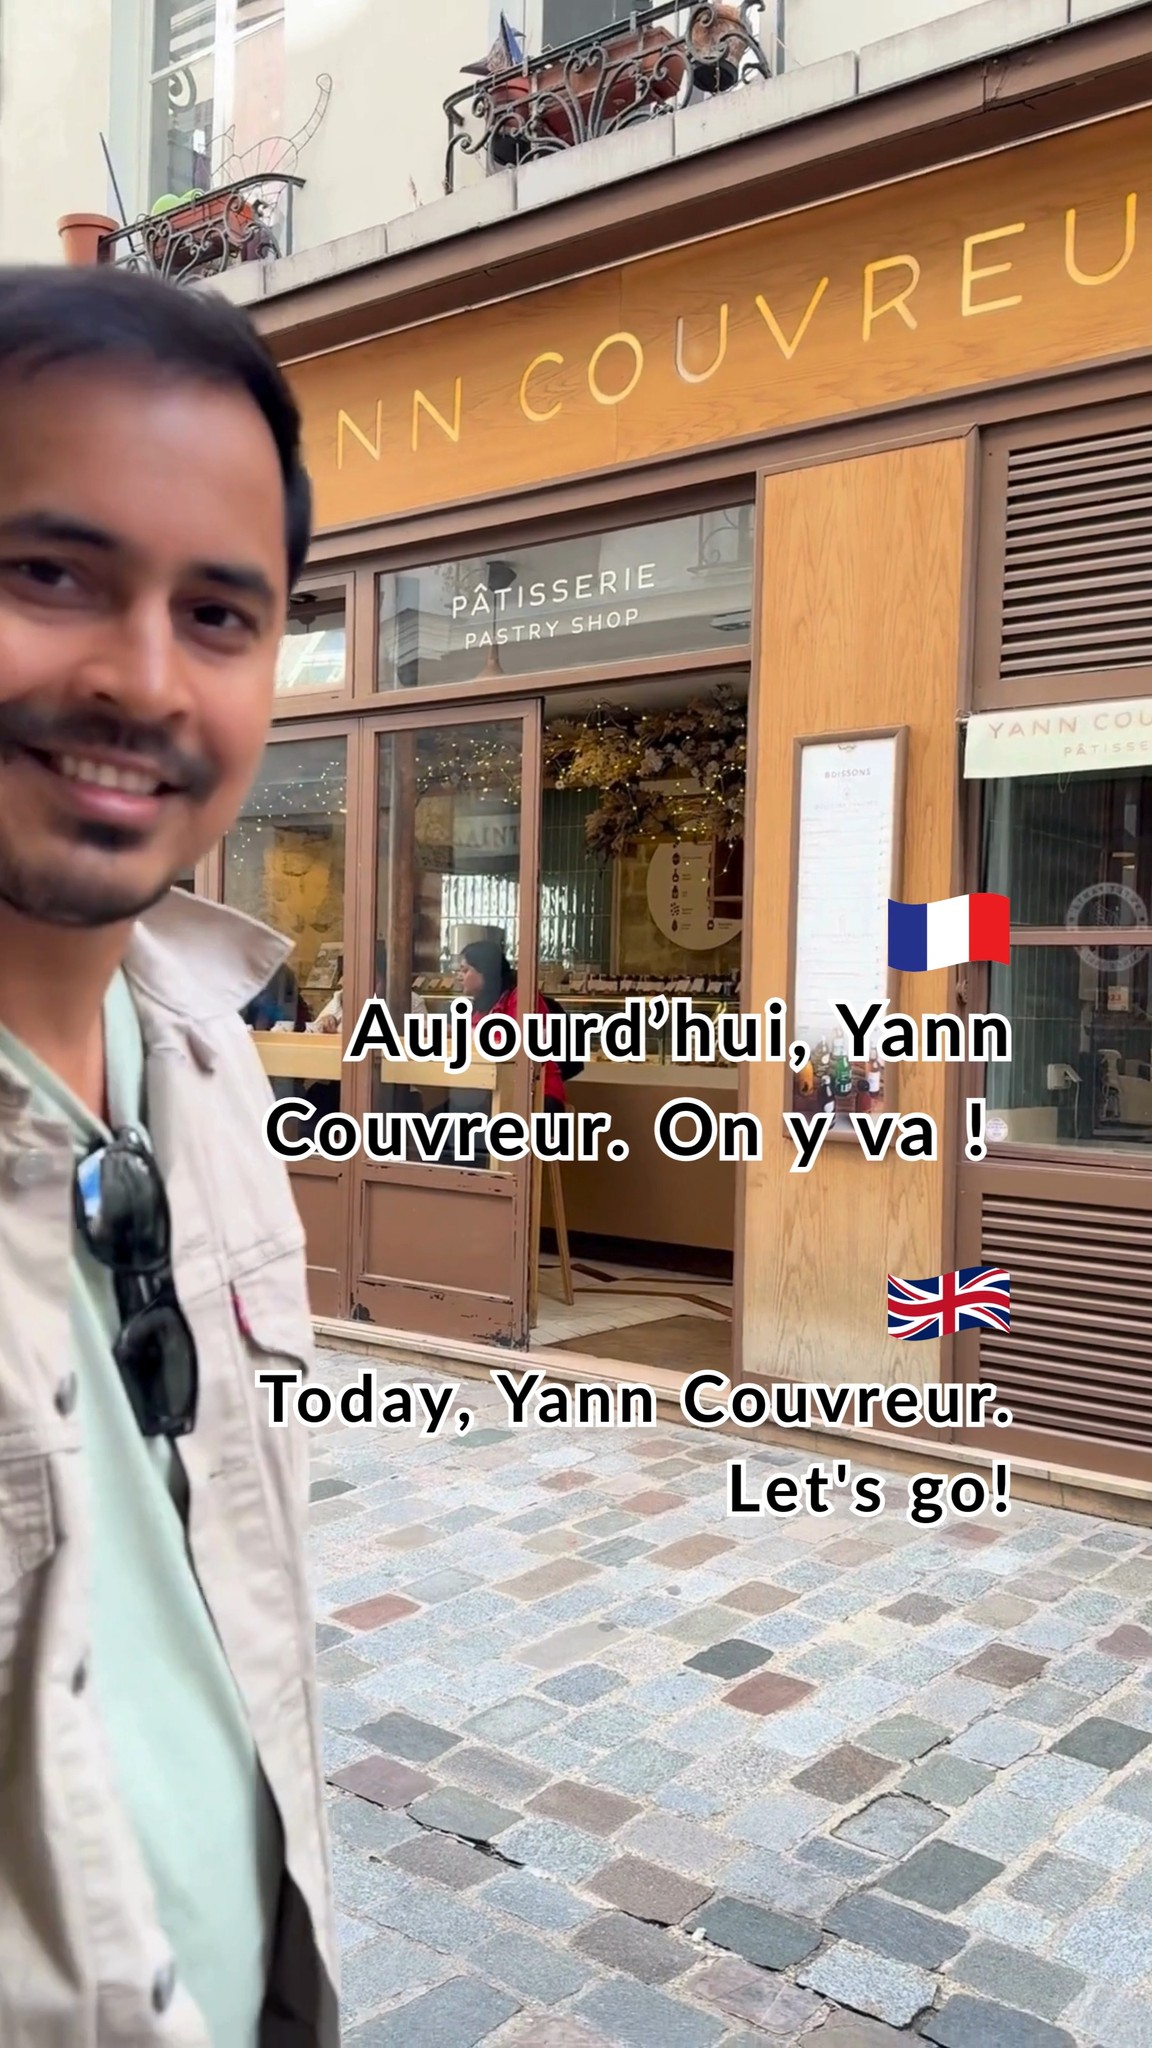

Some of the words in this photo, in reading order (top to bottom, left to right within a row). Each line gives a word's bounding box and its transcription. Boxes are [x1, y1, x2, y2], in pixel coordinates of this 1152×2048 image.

[451, 562, 657, 619] PÂTISSERIE
[464, 620, 560, 650] PASTRY
[571, 608, 639, 634] SHOP
[988, 716, 1078, 740] YANN
[824, 767, 871, 780] BOISSONS
